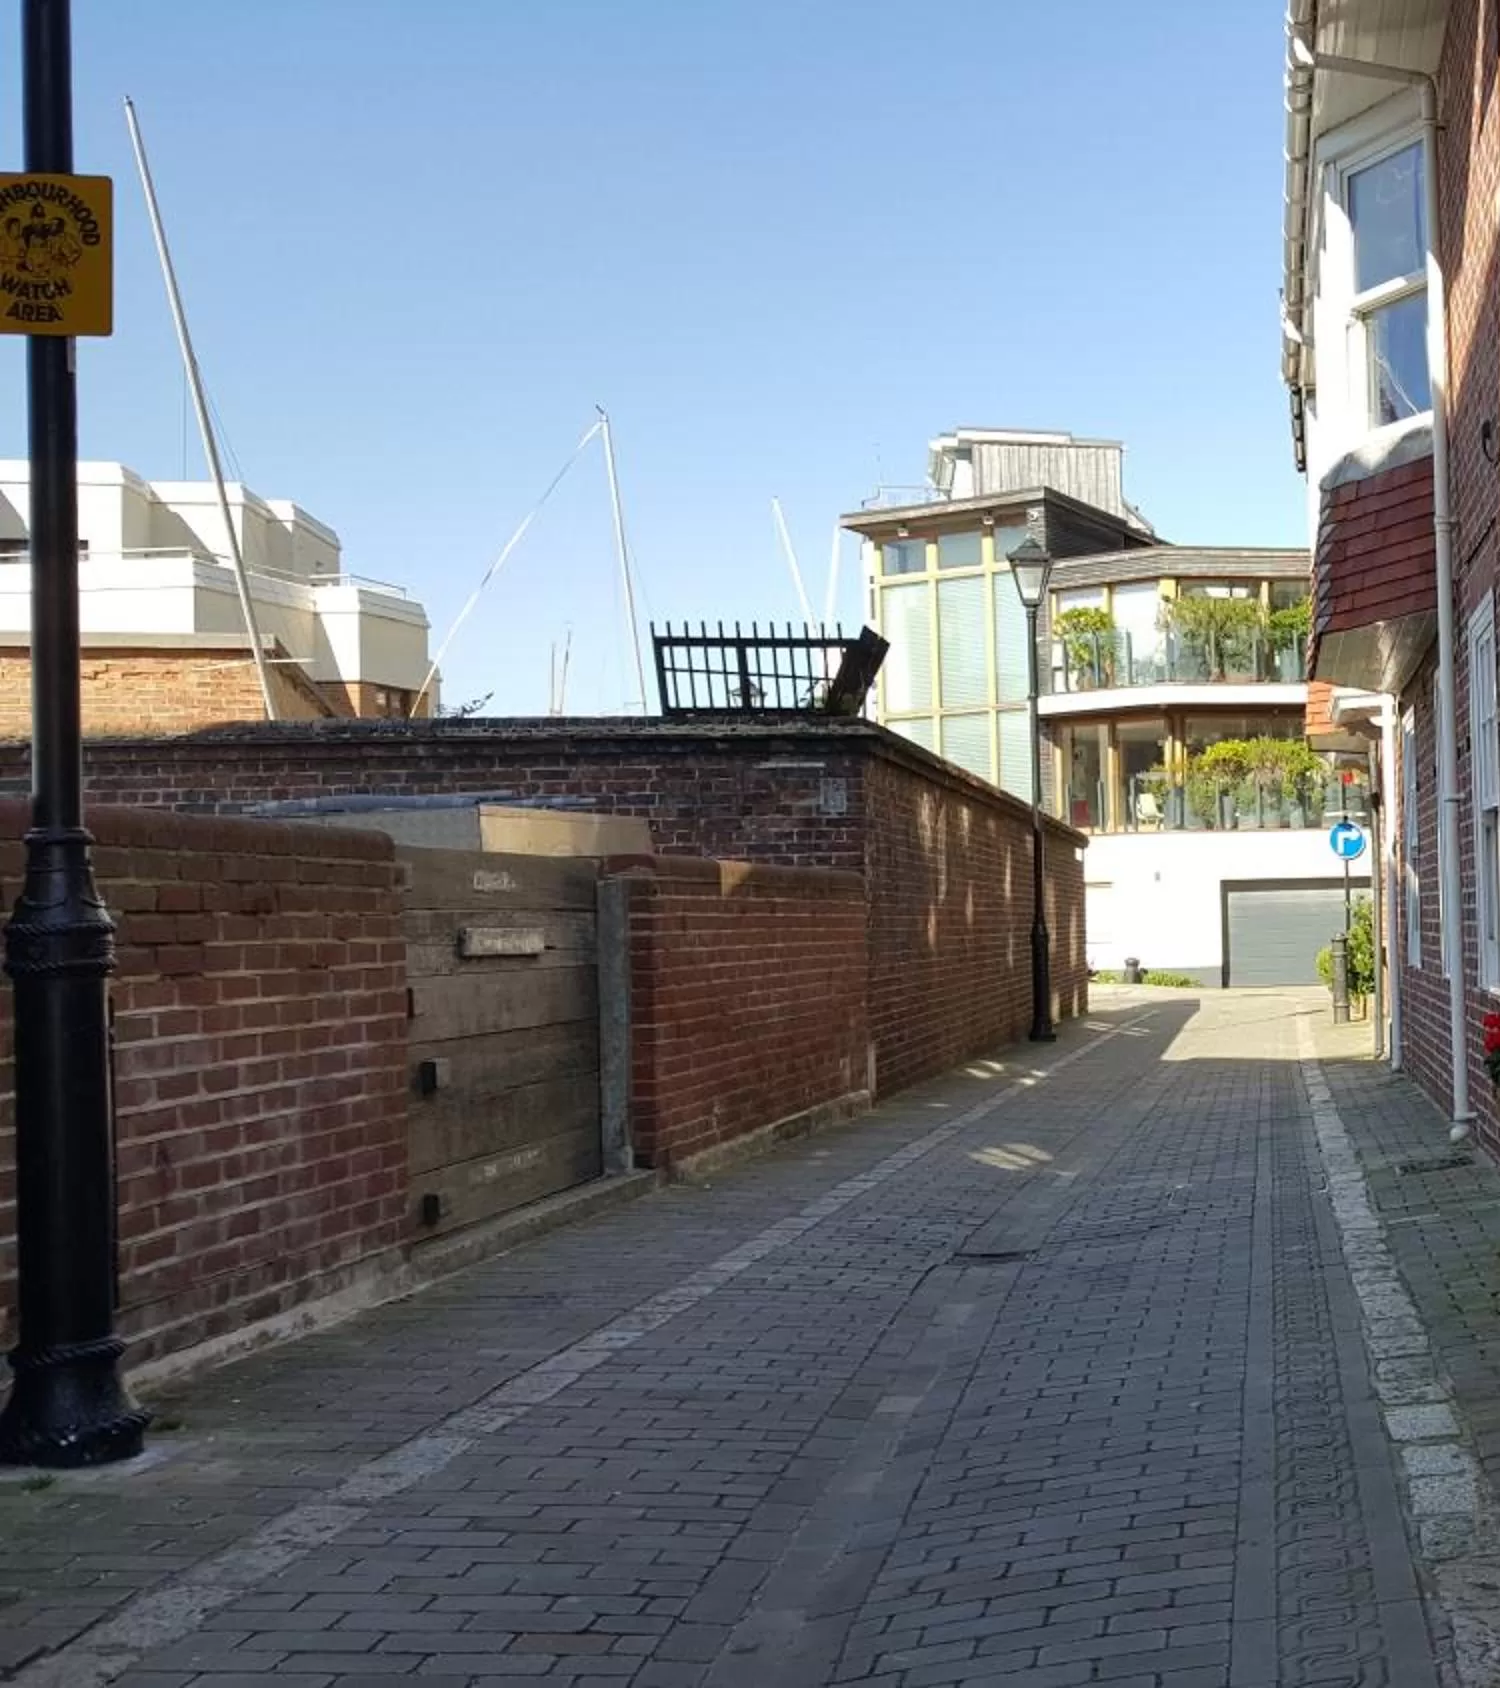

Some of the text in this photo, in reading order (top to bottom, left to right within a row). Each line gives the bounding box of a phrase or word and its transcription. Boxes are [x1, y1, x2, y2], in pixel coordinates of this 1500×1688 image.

[0, 181, 100, 246] HBOURHOOD
[0, 272, 72, 300] WATCH
[5, 302, 64, 322] AREA
